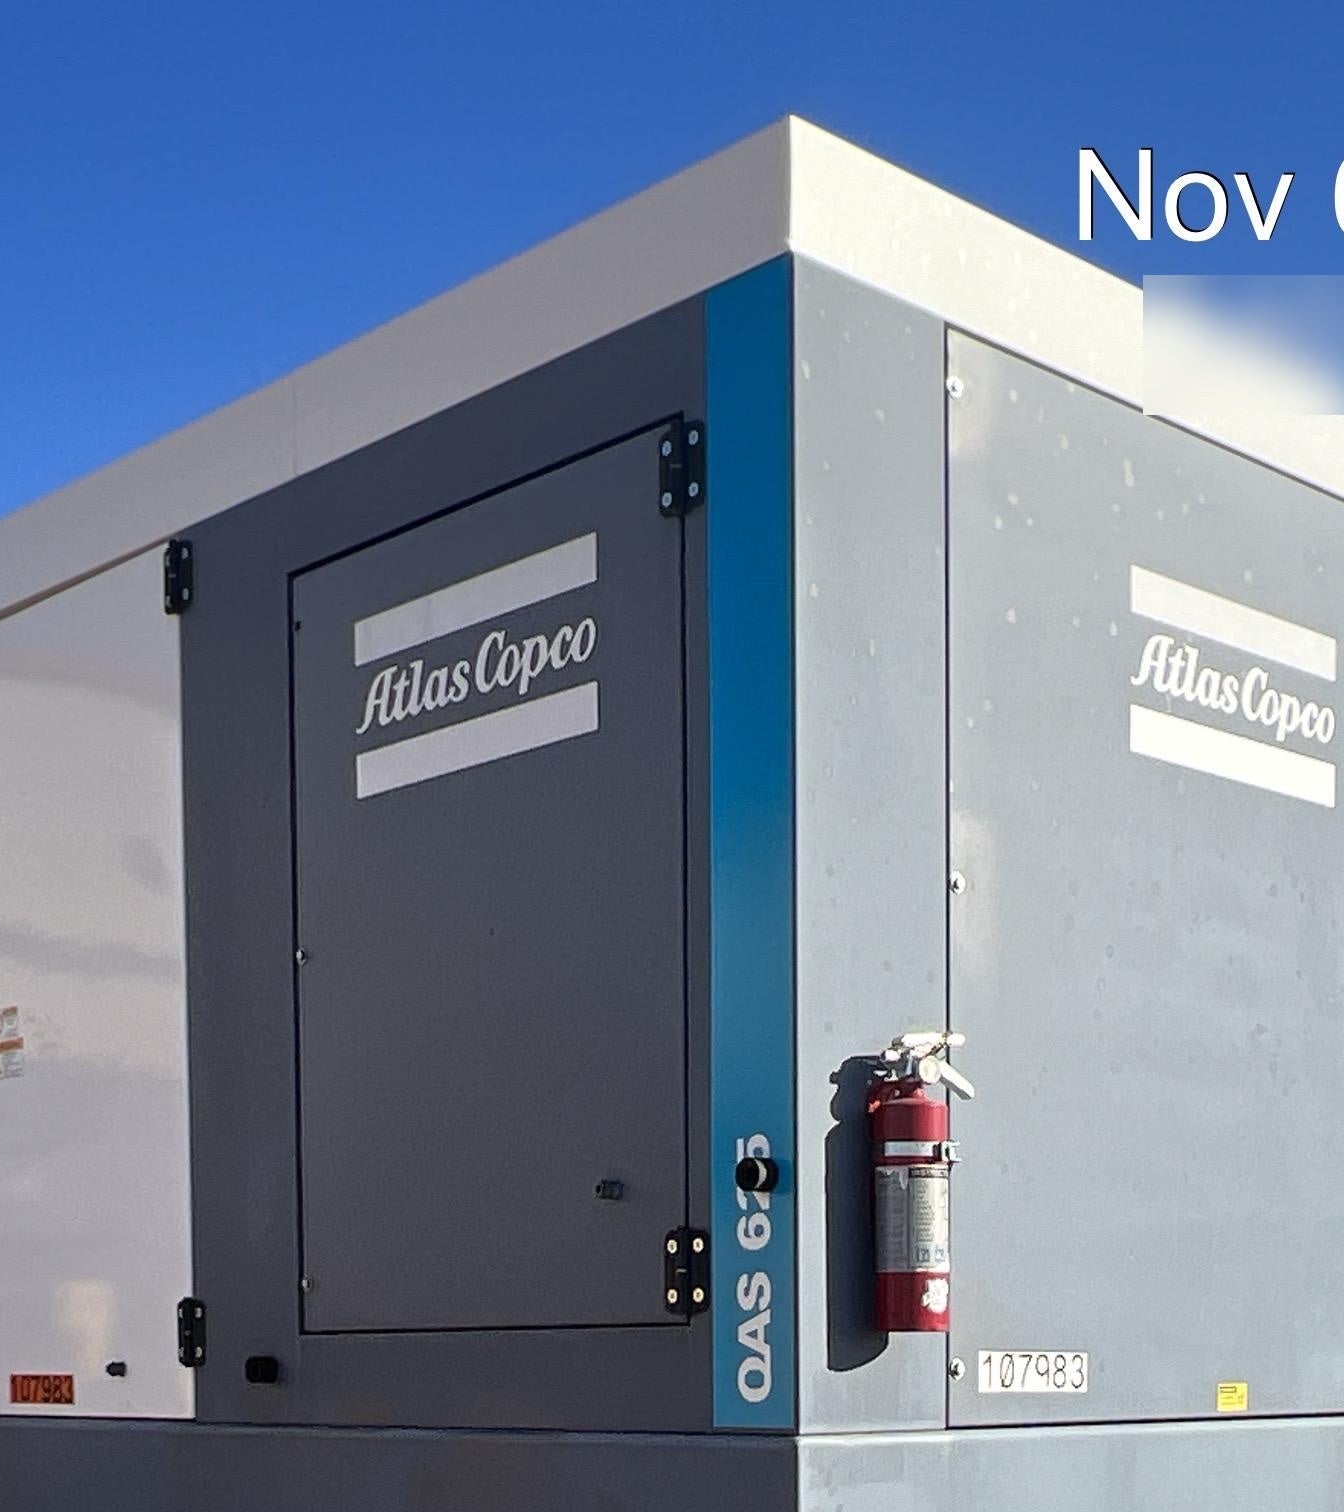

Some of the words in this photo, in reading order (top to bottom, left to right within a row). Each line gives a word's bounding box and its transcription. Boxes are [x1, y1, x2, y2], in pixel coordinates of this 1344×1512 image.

[355, 659, 471, 735] Atlas
[474, 617, 597, 696] Copco
[1129, 633, 1240, 715] Atlas
[1240, 666, 1336, 744] Copco
[982, 1352, 1085, 1389] 107983
